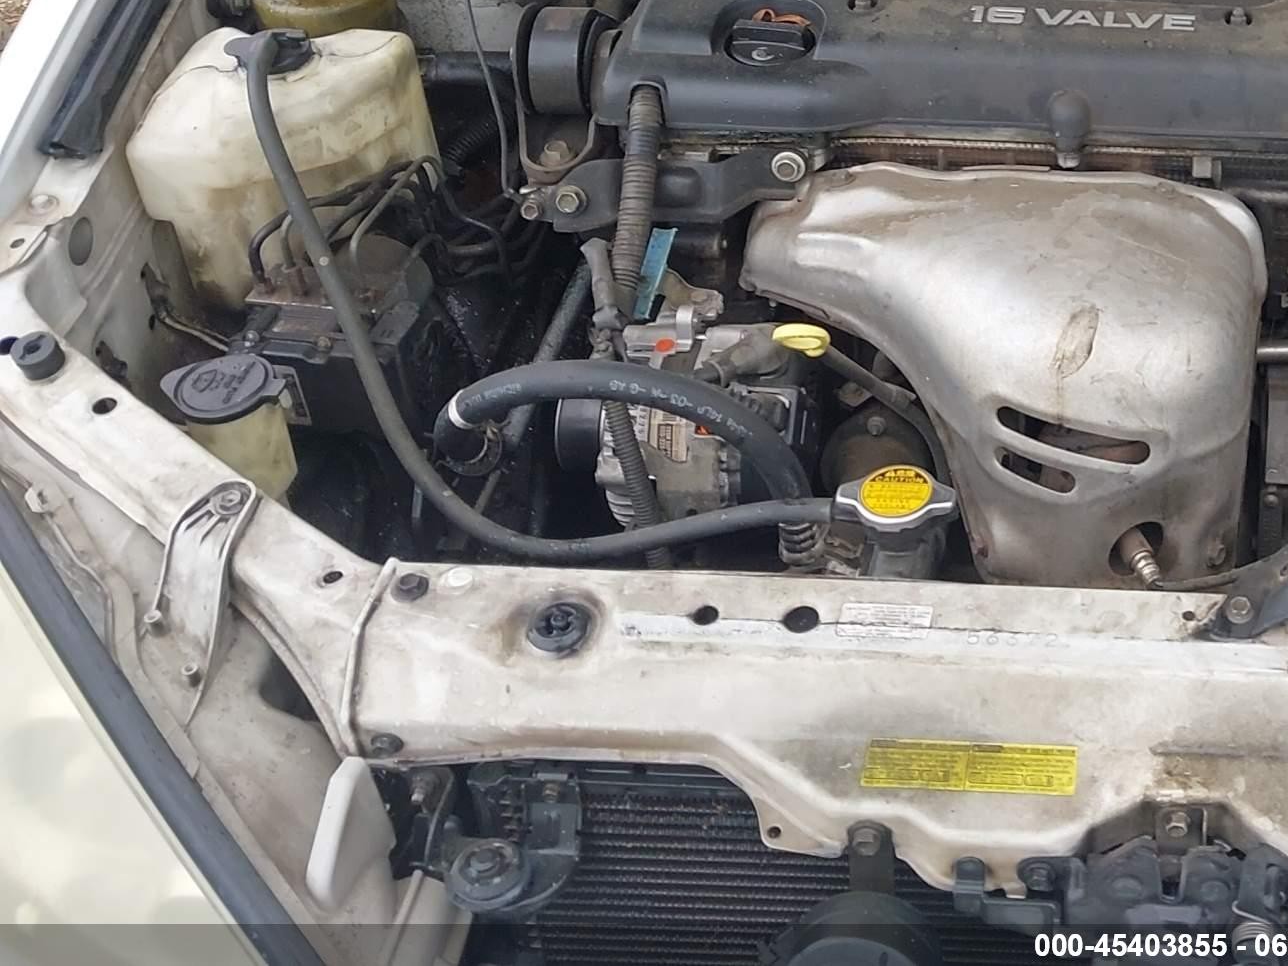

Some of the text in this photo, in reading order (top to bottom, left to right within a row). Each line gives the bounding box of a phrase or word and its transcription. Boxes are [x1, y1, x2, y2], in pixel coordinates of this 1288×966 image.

[970, 5, 1197, 32] 16 VALVE
[875, 475, 924, 484] CAUTION
